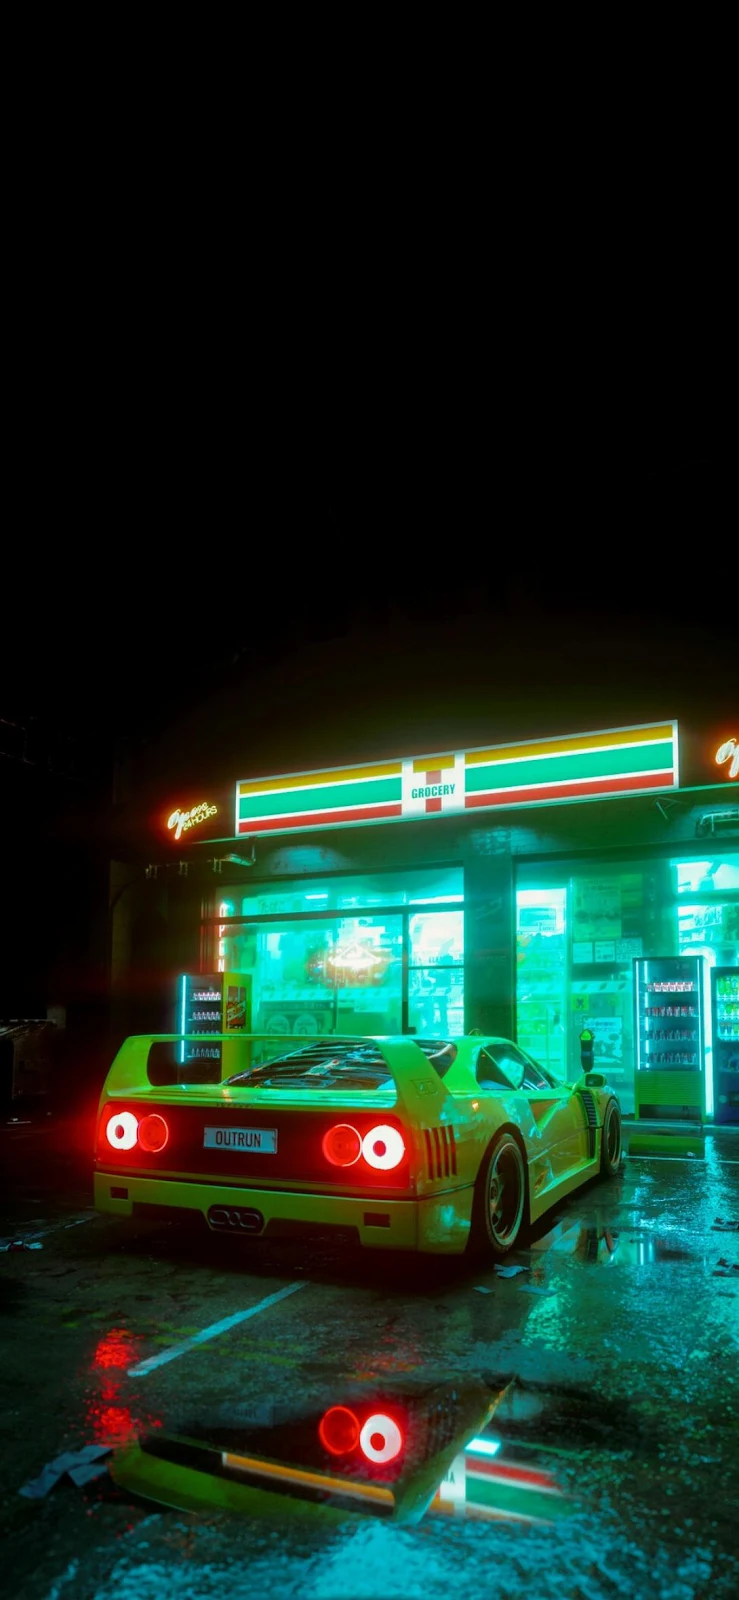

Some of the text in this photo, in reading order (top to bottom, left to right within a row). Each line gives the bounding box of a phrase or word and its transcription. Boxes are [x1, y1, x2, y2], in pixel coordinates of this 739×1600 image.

[411, 784, 455, 799] GROCERY
[167, 801, 209, 840] Open
[215, 1130, 262, 1148] OUTRUN
